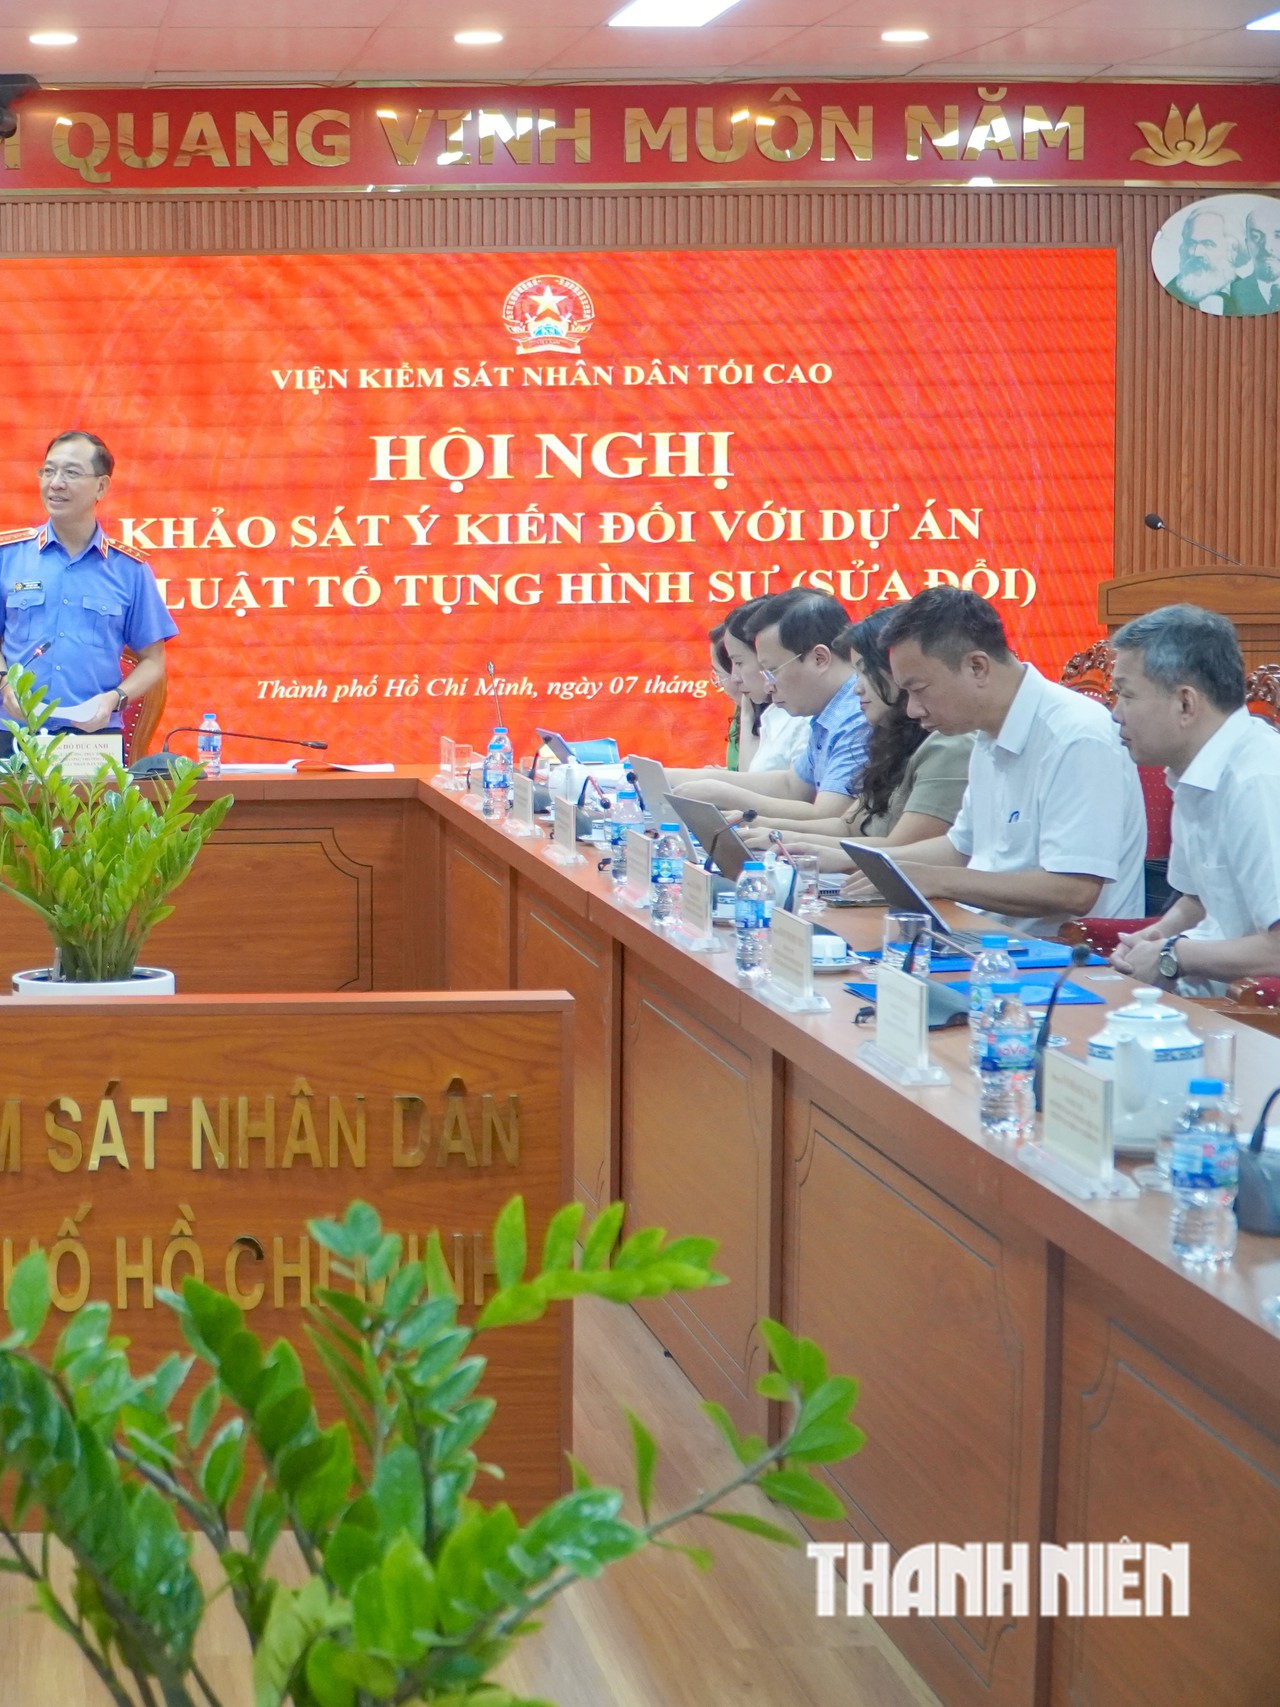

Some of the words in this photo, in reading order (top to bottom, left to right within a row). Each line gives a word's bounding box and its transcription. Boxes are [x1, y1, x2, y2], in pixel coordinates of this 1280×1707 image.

[52, 109, 352, 183] QUANG
[376, 107, 591, 167] VINH
[624, 87, 873, 164] MUÔN
[905, 86, 1086, 162] NĂM
[271, 365, 349, 396] VIỆN
[359, 362, 445, 389] KIỂM
[453, 360, 515, 388] SÁT
[522, 359, 615, 387] NHÂN
[623, 358, 690, 386] DÂN
[697, 358, 754, 386] TỐI
[763, 363, 833, 386] CAO
[369, 426, 516, 494] HỘI
[534, 431, 736, 491] NGHỊ
[119, 506, 277, 549] KHẢO
[290, 505, 390, 548] SÁT
[402, 504, 441, 547] Ý
[453, 503, 586, 546] KIẾN
[598, 501, 697, 545] ĐỐI
[709, 500, 806, 543] VỚI
[818, 502, 901, 550] DỰ
[909, 498, 984, 541] ÁN
[161, 571, 296, 617] LUẬT
[307, 565, 381, 608] TỐ
[394, 573, 544, 615] TỤNG
[556, 562, 695, 605] HÌNH
[257, 679, 328, 699] Thành
[332, 674, 379, 703] phố
[384, 674, 420, 698] Hồ
[426, 677, 469, 697] Chí
[474, 676, 539, 700] Minh,
[547, 676, 604, 702] ngày
[609, 676, 639, 695] 07
[644, 674, 710, 699] tháng
[45, 1080, 169, 1172] SÁT
[190, 1077, 367, 1170] NHÂN
[392, 1075, 520, 1170] DÂN
[116, 1203, 205, 1310] HỒ
